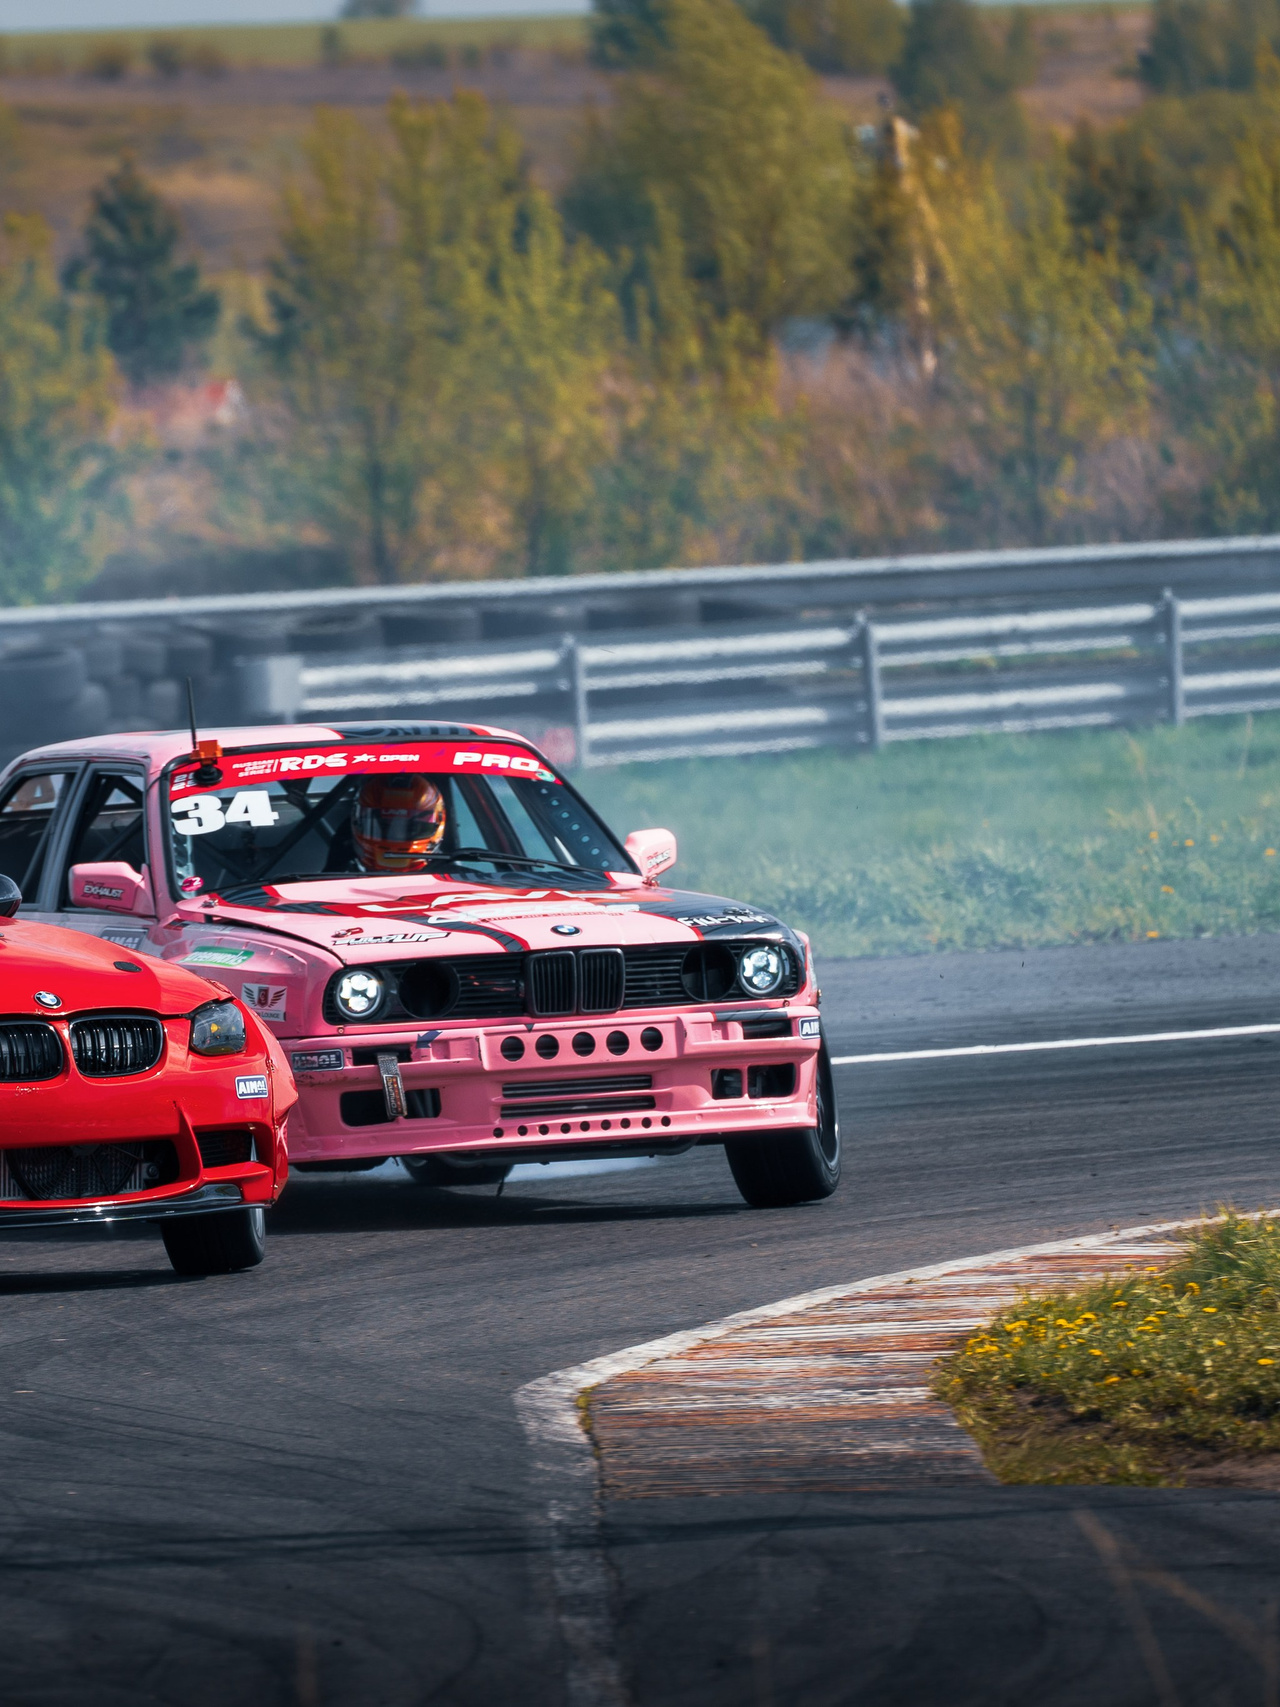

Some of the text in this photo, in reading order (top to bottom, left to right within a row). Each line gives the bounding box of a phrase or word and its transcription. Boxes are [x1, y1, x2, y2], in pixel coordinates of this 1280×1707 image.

[232, 759, 275, 769] RUSSIAN
[280, 753, 348, 772] RDS
[379, 754, 420, 762] OPEN
[453, 751, 541, 772] PRO
[238, 768, 272, 778] SERIES
[170, 790, 279, 836] 34
[84, 884, 124, 898] EXHAUST
[239, 1080, 267, 1094] AIMOL
